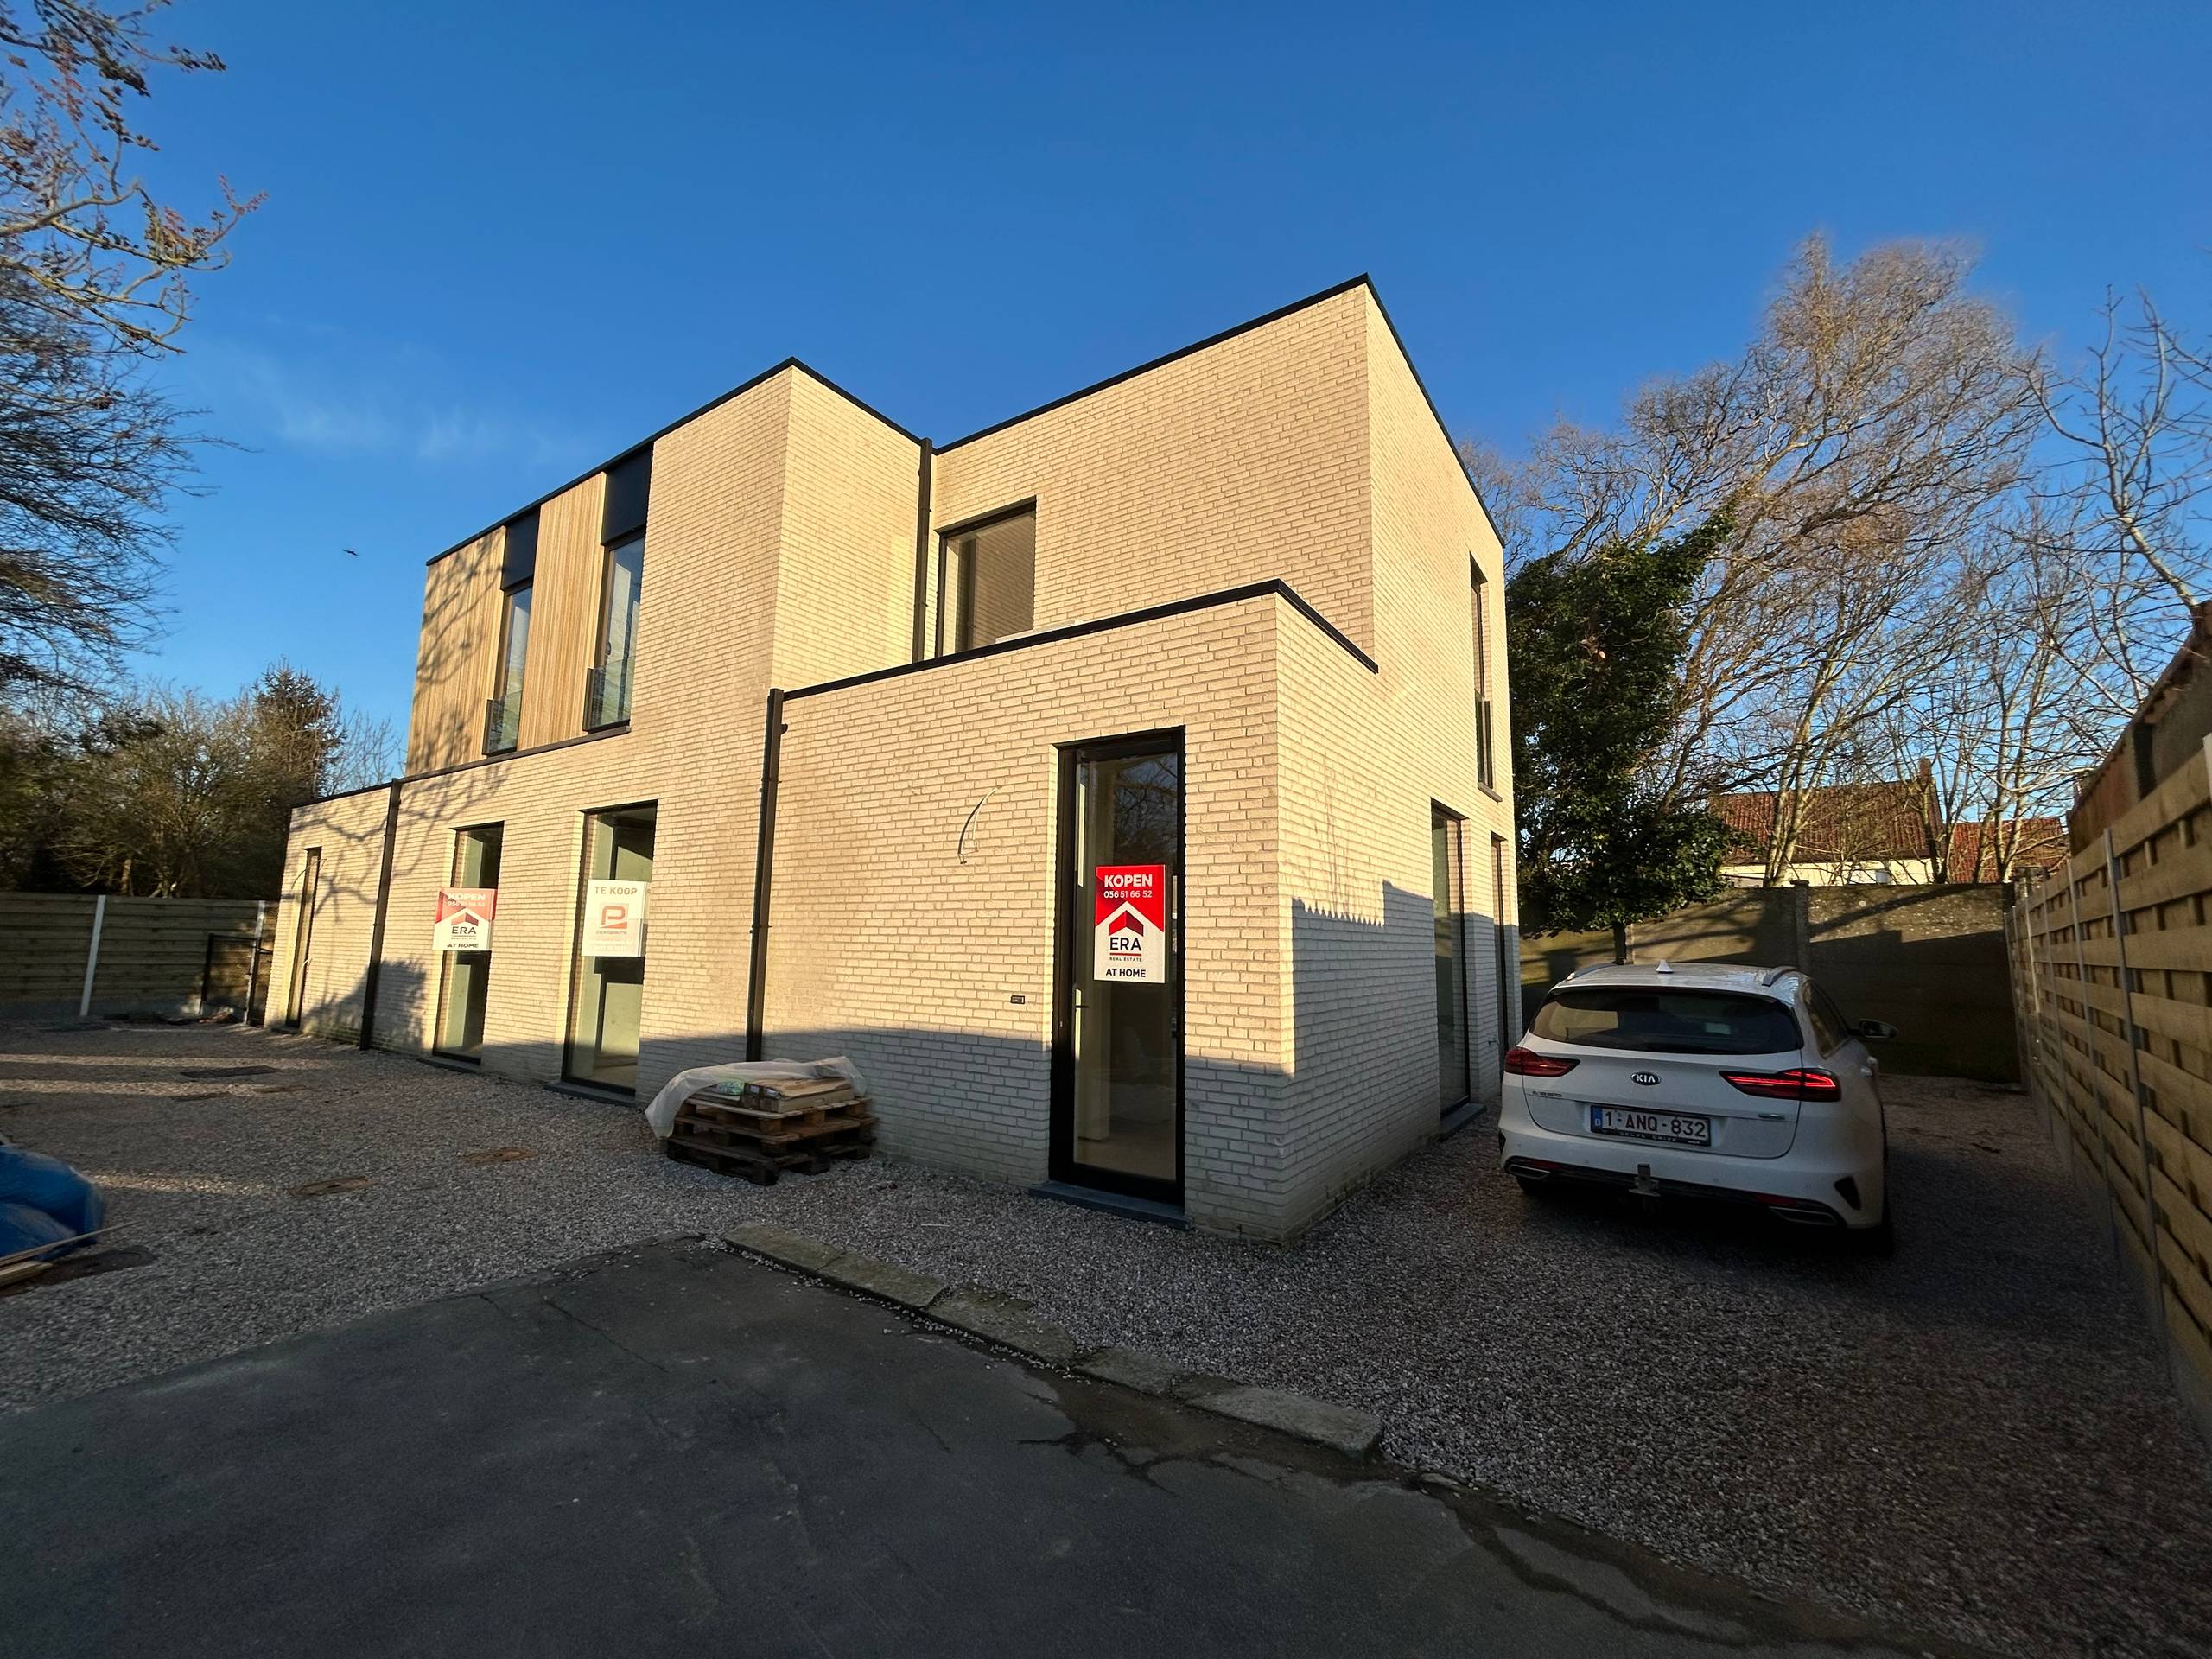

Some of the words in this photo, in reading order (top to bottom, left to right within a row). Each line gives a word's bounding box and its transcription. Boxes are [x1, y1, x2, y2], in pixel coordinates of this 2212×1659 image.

[1103, 874, 1153, 887] KOPEN
[609, 887, 638, 895] KOOP
[1103, 890, 1119, 899] 056
[1120, 890, 1128, 899] 51
[1129, 890, 1141, 899] 66
[1142, 890, 1153, 899] 52
[1109, 938, 1142, 950] ERA
[1119, 969, 1147, 977] HOME
[1636, 1074, 1656, 1083] KIA
